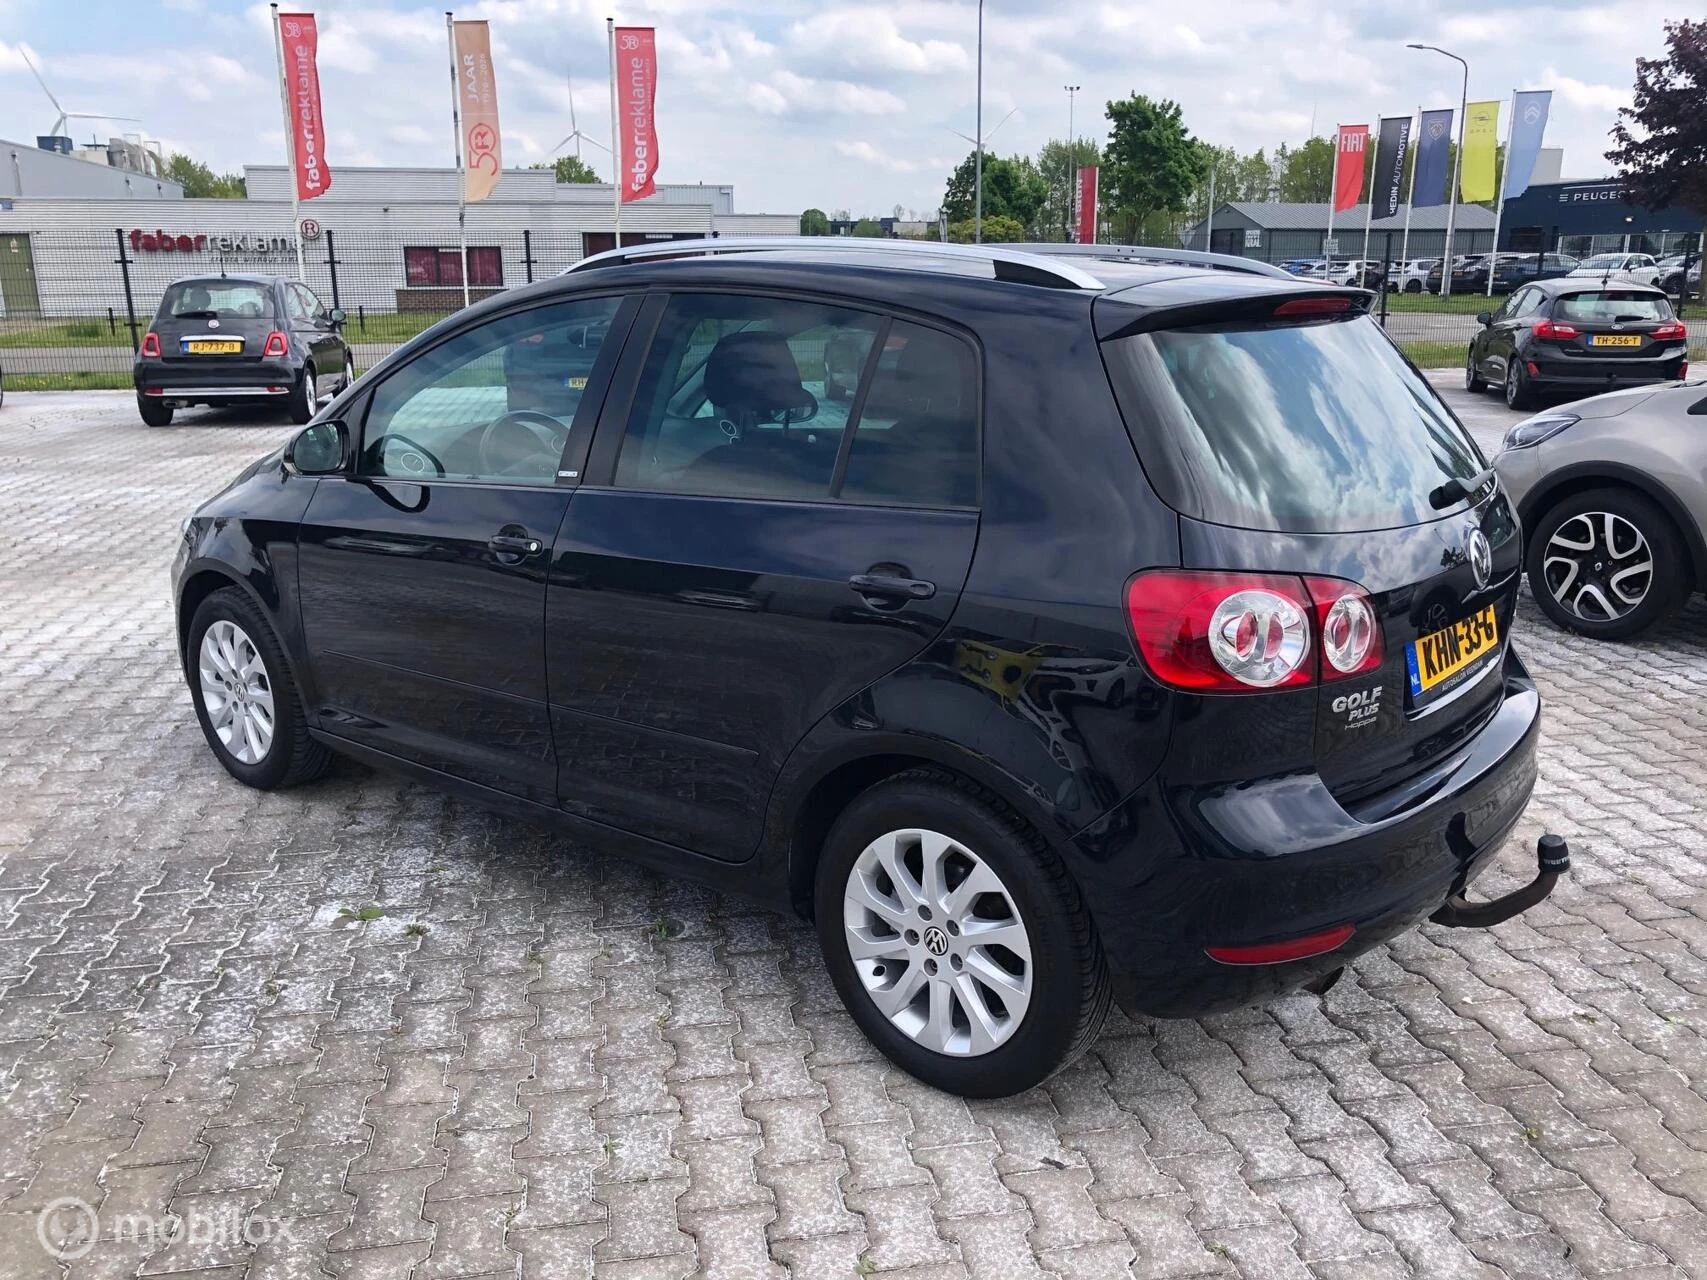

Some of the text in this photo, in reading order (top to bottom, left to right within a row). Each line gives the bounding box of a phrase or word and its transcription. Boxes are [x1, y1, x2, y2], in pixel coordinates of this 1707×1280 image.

[463, 53, 479, 105] JAAR
[1340, 132, 1366, 152] FIAT
[1393, 123, 1409, 184] AUTOMOTIVE
[1596, 336, 1639, 345] TH-256-T
[1332, 686, 1382, 713] GOLF
[1348, 702, 1380, 721] PLUS
